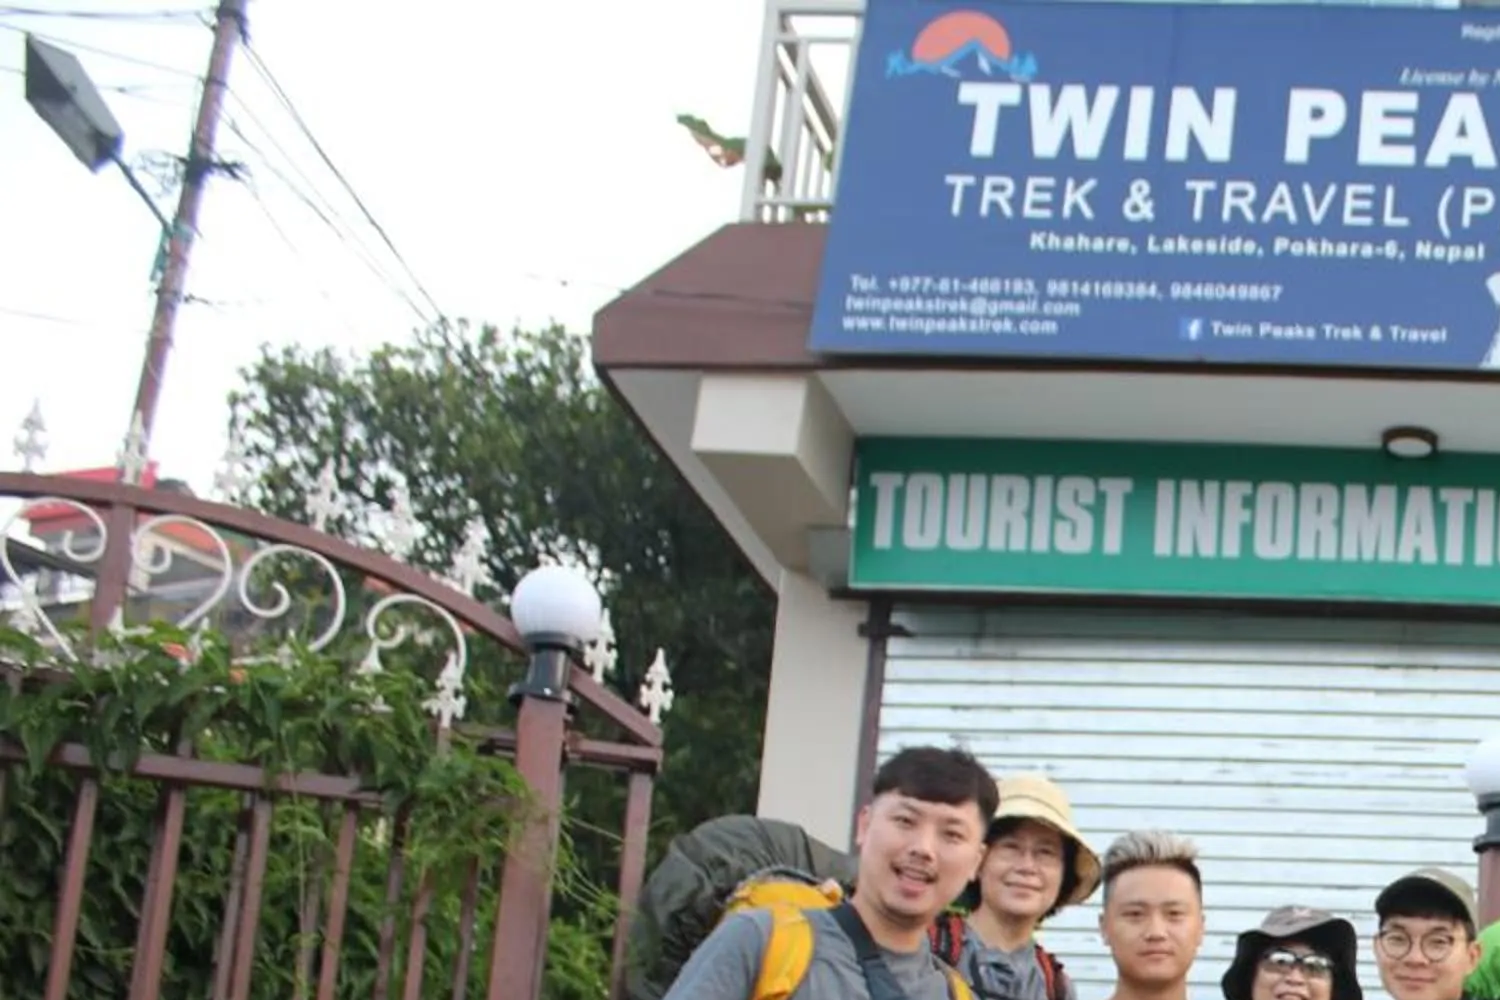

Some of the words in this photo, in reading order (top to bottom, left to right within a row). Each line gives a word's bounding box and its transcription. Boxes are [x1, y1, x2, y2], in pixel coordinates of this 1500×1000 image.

[957, 81, 1237, 163] TWIN
[944, 175, 1098, 220] TREK
[1122, 179, 1156, 223] &
[1185, 180, 1411, 228] TRAVEL
[1147, 234, 1265, 258] Lakeside,
[1414, 240, 1486, 264] Nepal
[1211, 320, 1253, 338] Twin
[1259, 321, 1316, 340] Peaks
[1321, 323, 1364, 341] Trek
[1369, 325, 1383, 342] &
[1389, 325, 1448, 344] Travel
[869, 471, 1133, 556] TOURIST
